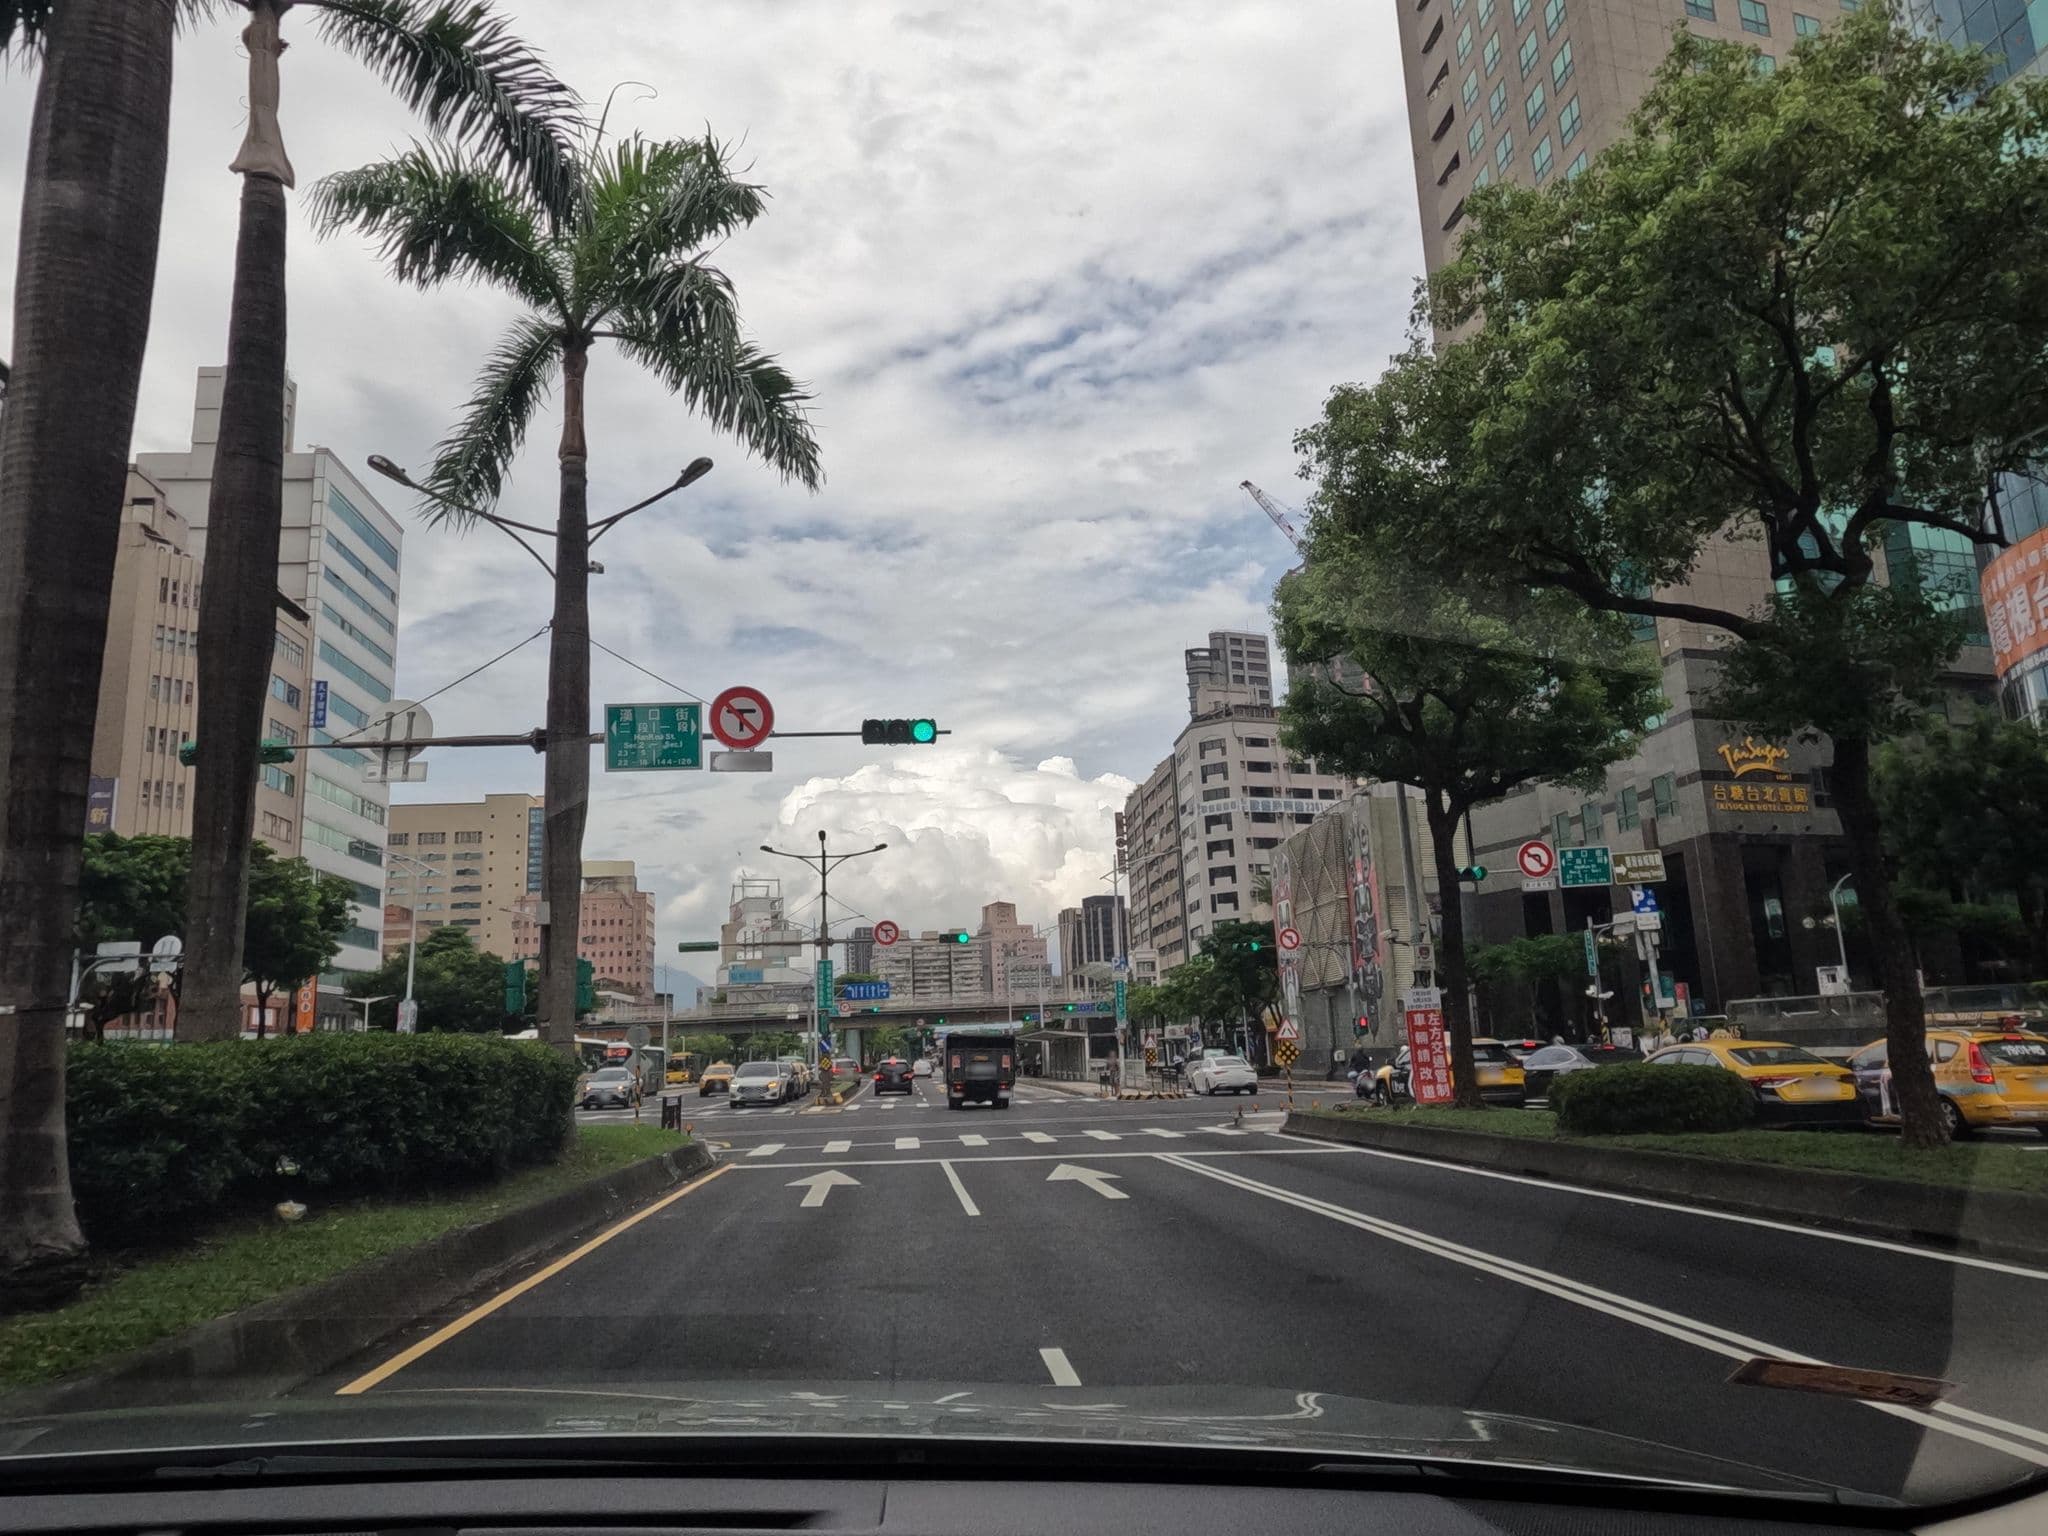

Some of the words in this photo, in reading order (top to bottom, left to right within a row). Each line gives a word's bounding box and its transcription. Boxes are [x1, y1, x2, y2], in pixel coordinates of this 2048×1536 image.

[1717, 735, 1790, 774] TaiSugar
[1428, 1012, 1451, 1097] 左方交通管制
